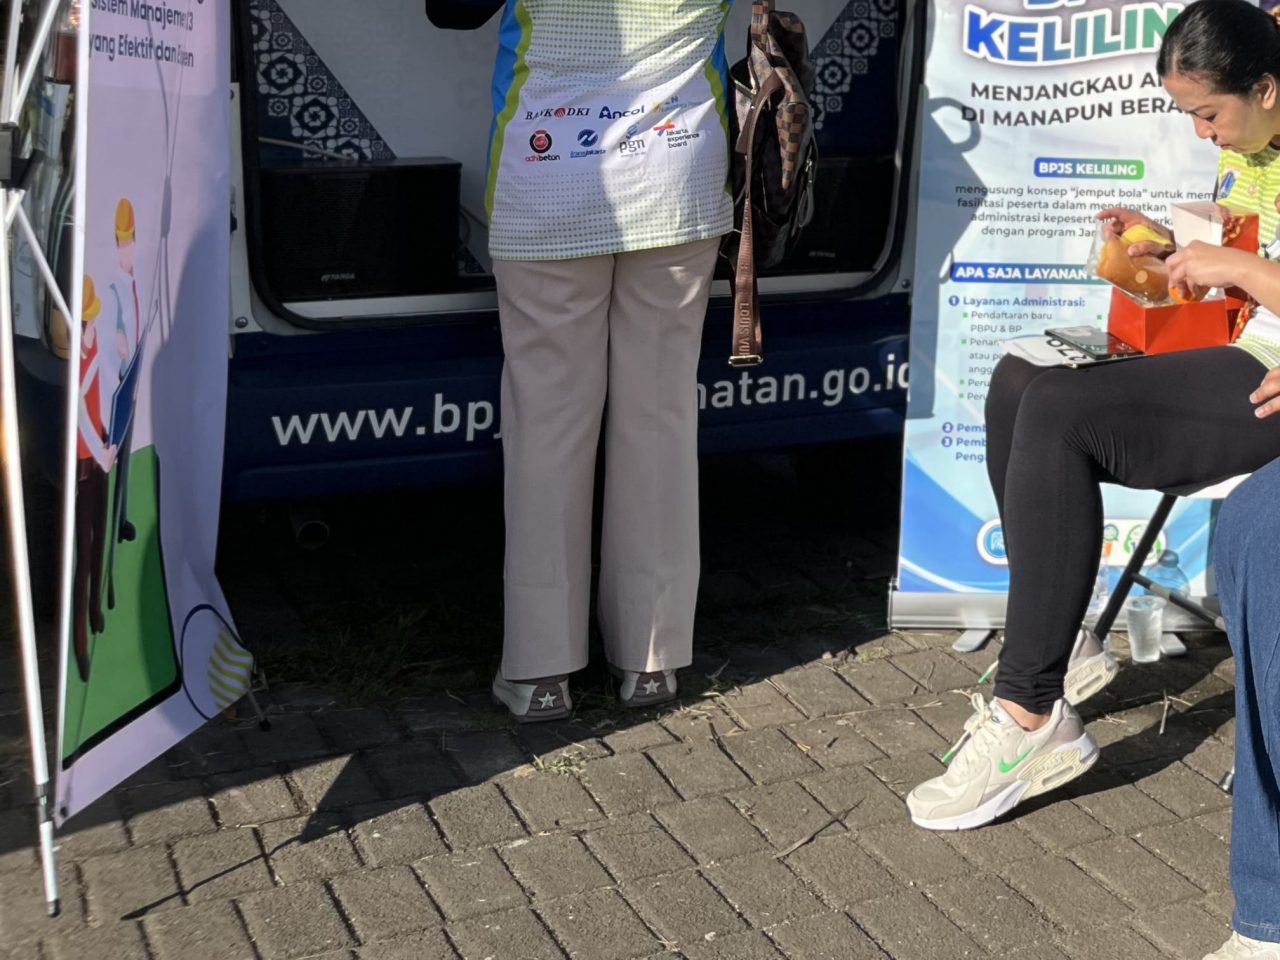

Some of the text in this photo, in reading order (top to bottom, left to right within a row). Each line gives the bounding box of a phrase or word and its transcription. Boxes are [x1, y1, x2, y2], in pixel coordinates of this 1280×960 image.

[118, 34, 153, 60] Efektif
[970, 72, 1133, 102] MENJANGKAU
[567, 107, 591, 117] DKI
[599, 105, 645, 120] Ancol
[961, 105, 985, 124] DI
[993, 102, 1112, 127] MANAPUN
[619, 138, 646, 153] pgn
[668, 141, 687, 149] board
[1038, 162, 1138, 176] BPJS KELILING
[955, 186, 1024, 197] mengusung
[1027, 187, 1067, 198] konsep
[1150, 189, 1183, 199] untuk
[957, 197, 1004, 208] fasilitasi
[1007, 200, 1049, 211] peserta
[1052, 199, 1086, 210] dalam
[970, 212, 1040, 223] administrasi
[981, 226, 1024, 237] dengan
[1027, 228, 1076, 239] program
[955, 267, 984, 278] APA
[986, 267, 1022, 279] SAJA
[1025, 268, 1088, 280] LAYANAN
[963, 297, 1010, 308] Layanan
[1012, 297, 1086, 307] Administrasi:
[739, 302, 750, 334] LOUIS
[971, 311, 1053, 320] Pendaftaran baru
[970, 324, 1022, 333] PBPU & BP
